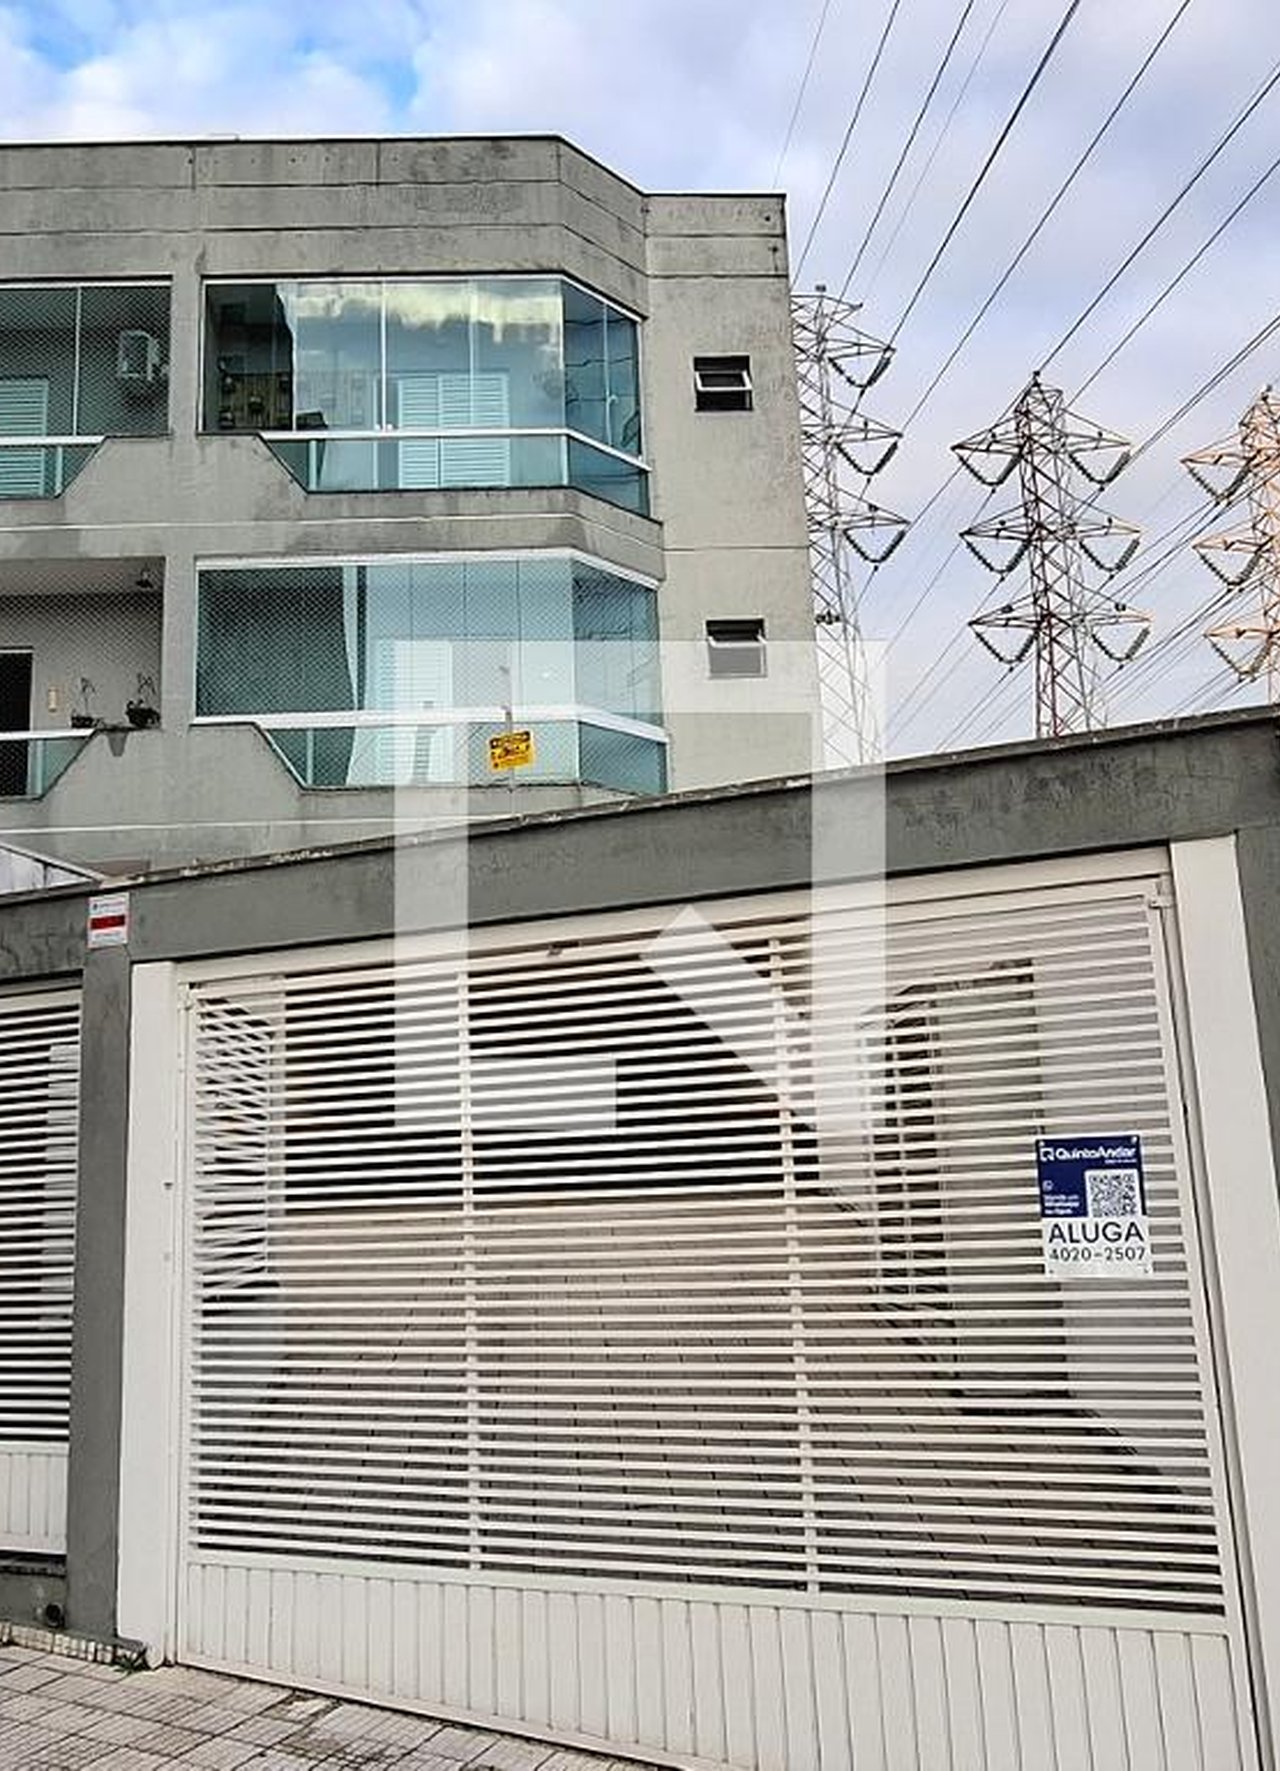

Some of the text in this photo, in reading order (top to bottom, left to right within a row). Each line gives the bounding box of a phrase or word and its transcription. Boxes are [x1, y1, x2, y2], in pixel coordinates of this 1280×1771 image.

[1055, 1146, 1136, 1160] QuintoAndar
[1049, 1222, 1144, 1244] ALUGA
[1049, 1246, 1146, 1262] 4020-2507
